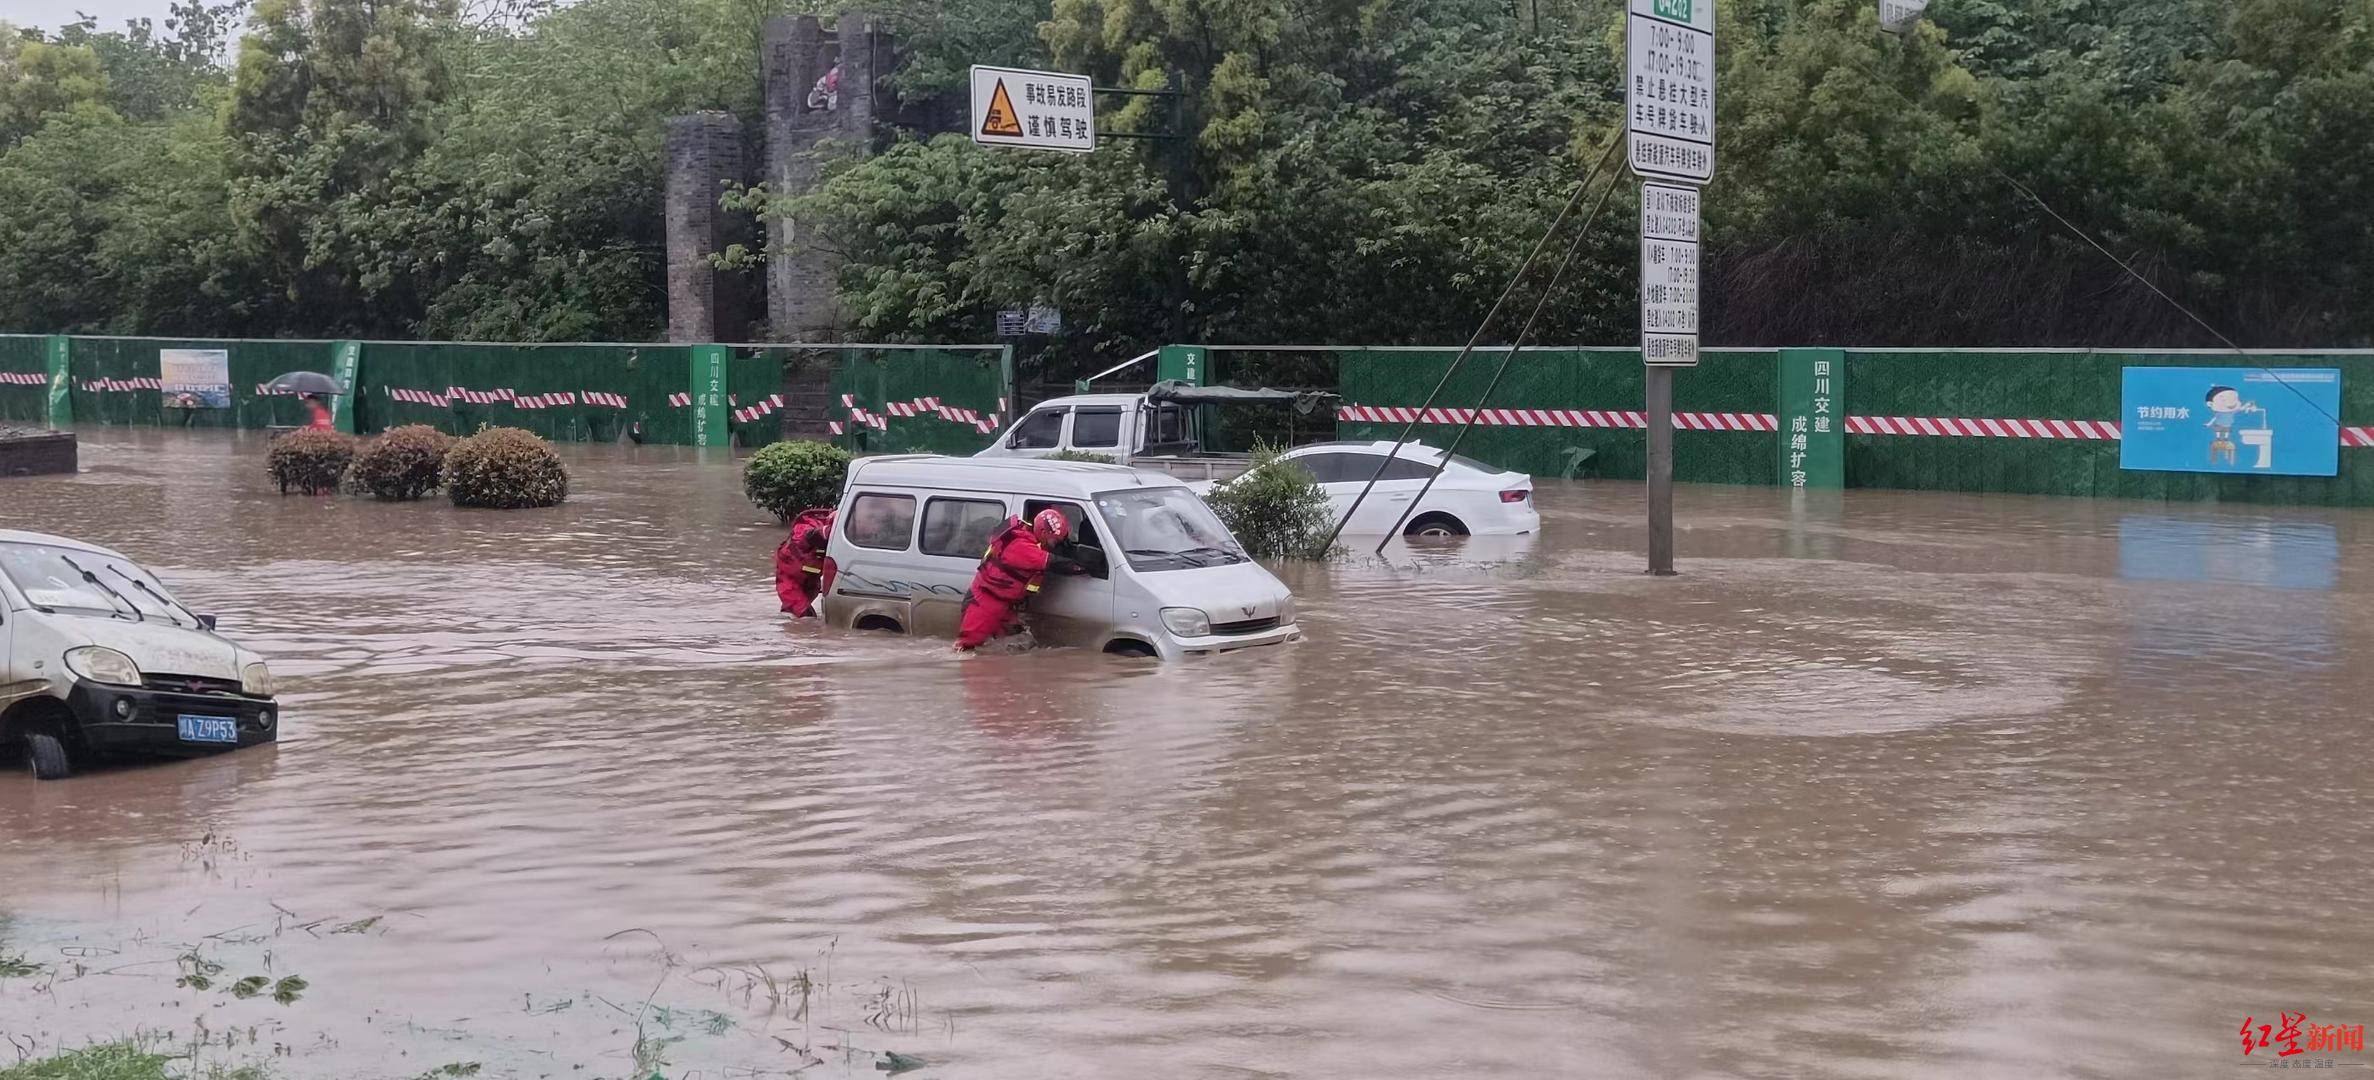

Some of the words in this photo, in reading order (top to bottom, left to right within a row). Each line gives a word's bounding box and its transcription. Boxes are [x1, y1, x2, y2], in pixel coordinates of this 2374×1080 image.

[1025, 83, 1087, 108] 事故易发路段
[1028, 115, 1088, 140] 谨慎驾驶
[1814, 361, 1831, 433] 四川交建
[2136, 406, 2190, 419] 节约用水
[1790, 416, 1807, 487] 成绵扩容
